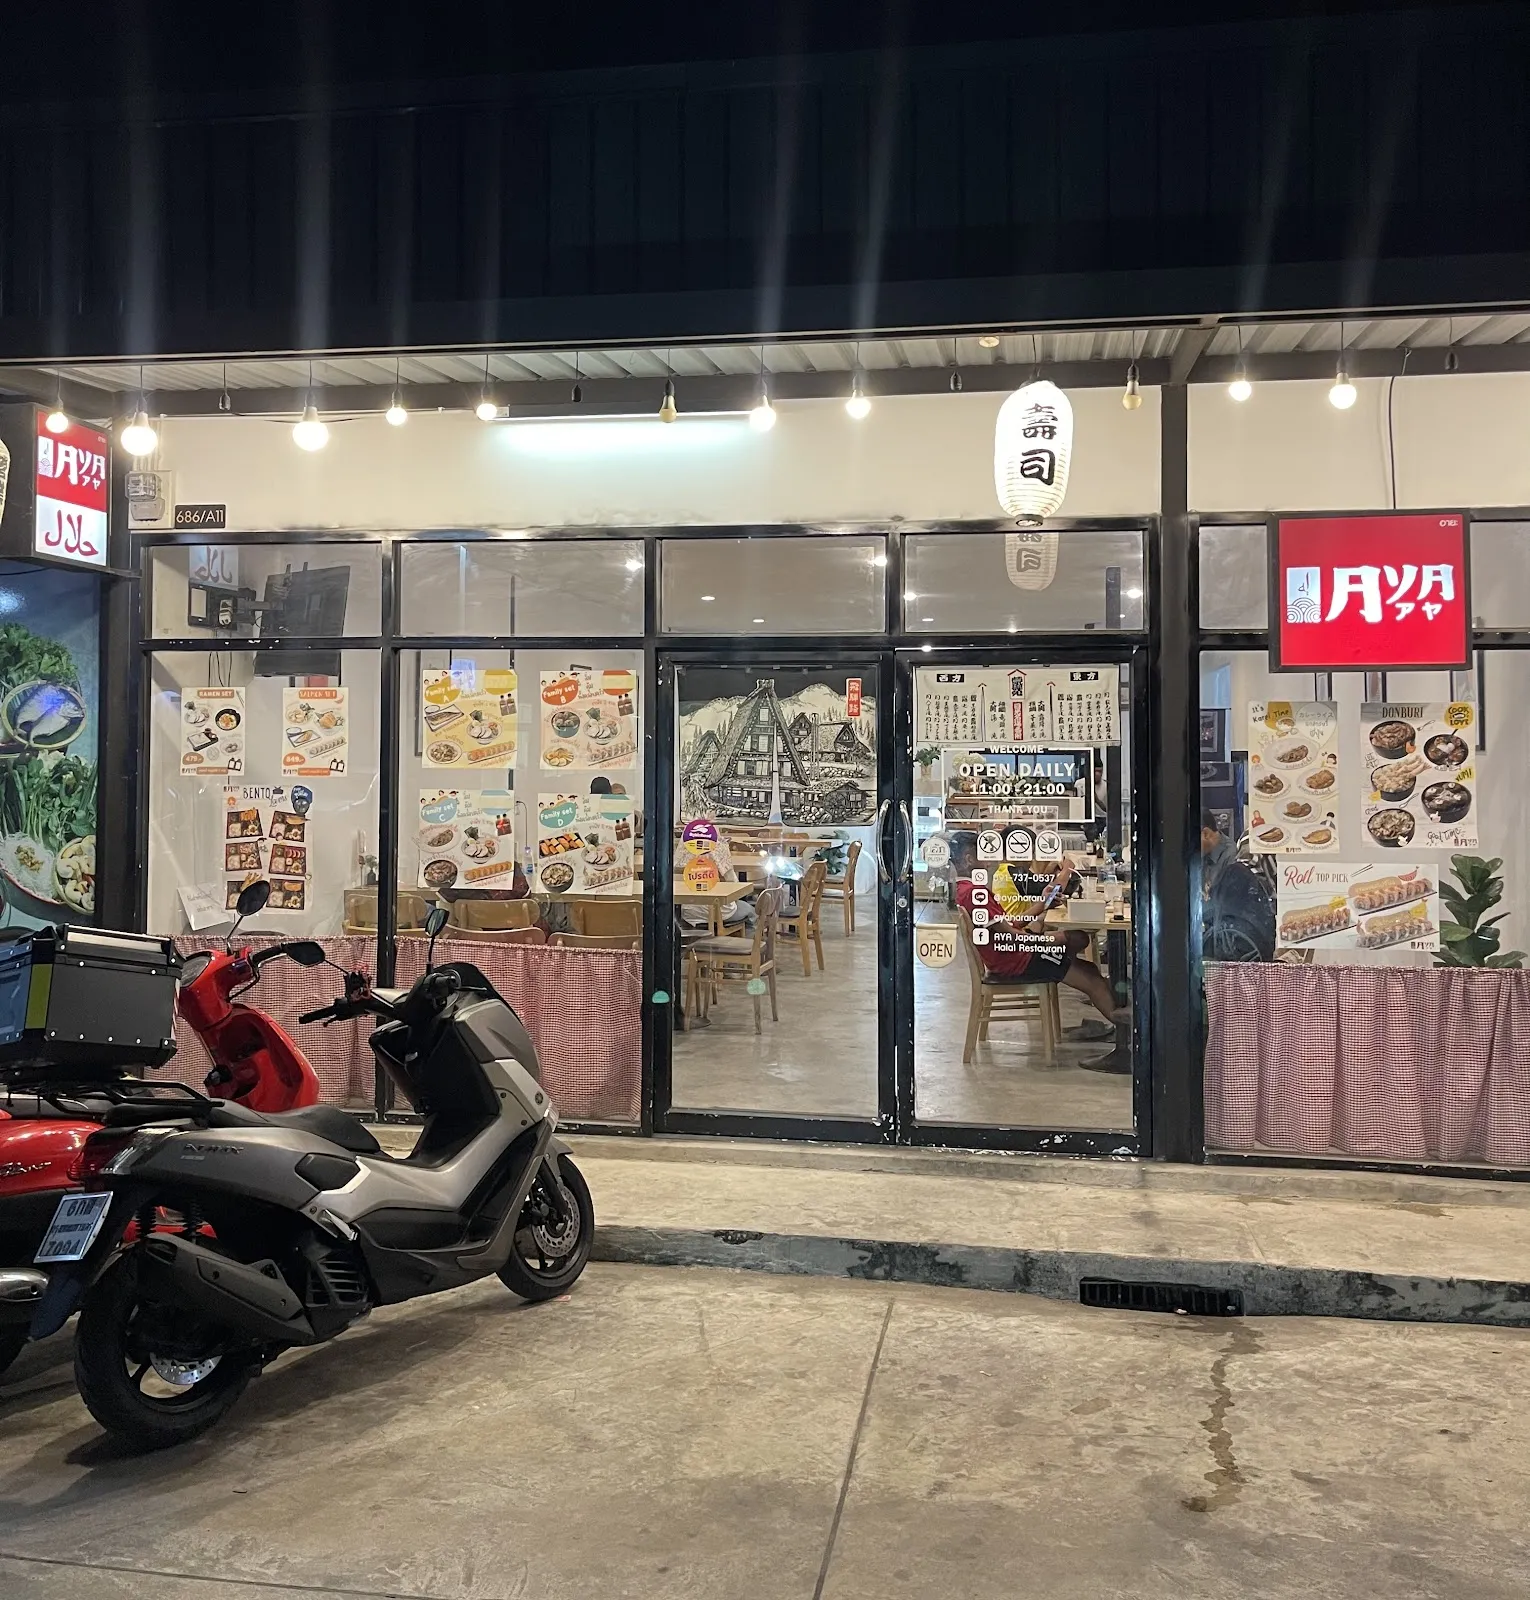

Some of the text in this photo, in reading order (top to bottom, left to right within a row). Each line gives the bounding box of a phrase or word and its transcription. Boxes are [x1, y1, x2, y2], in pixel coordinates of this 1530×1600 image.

[54, 442, 106, 485] AYA
[176, 509, 224, 524] 686/A11
[44, 509, 99, 557] حلال
[1325, 564, 1455, 623] AYA
[1395, 602, 1442, 621] アヤ
[543, 684, 576, 698] Family set
[443, 695, 450, 703] A
[560, 696, 567, 704] B
[1382, 707, 1423, 718] DONBURI
[990, 745, 1044, 754] WELCOME
[959, 763, 1076, 777] OPEN DAILY
[243, 787, 270, 799] BENTO
[970, 783, 1011, 795] 11:00
[1024, 783, 1066, 795] 21:00
[422, 803, 454, 816] Family set
[540, 807, 573, 820] Family set
[988, 805, 1048, 814] THANK YOU
[439, 814, 446, 822] C
[558, 819, 564, 827] D
[1284, 865, 1348, 890] Roll TOP PICK
[994, 914, 1038, 923] ayahararu
[994, 933, 1055, 943] AYA Japanese
[919, 943, 953, 957] OPEN
[994, 944, 1066, 953] Halal Restaurant
